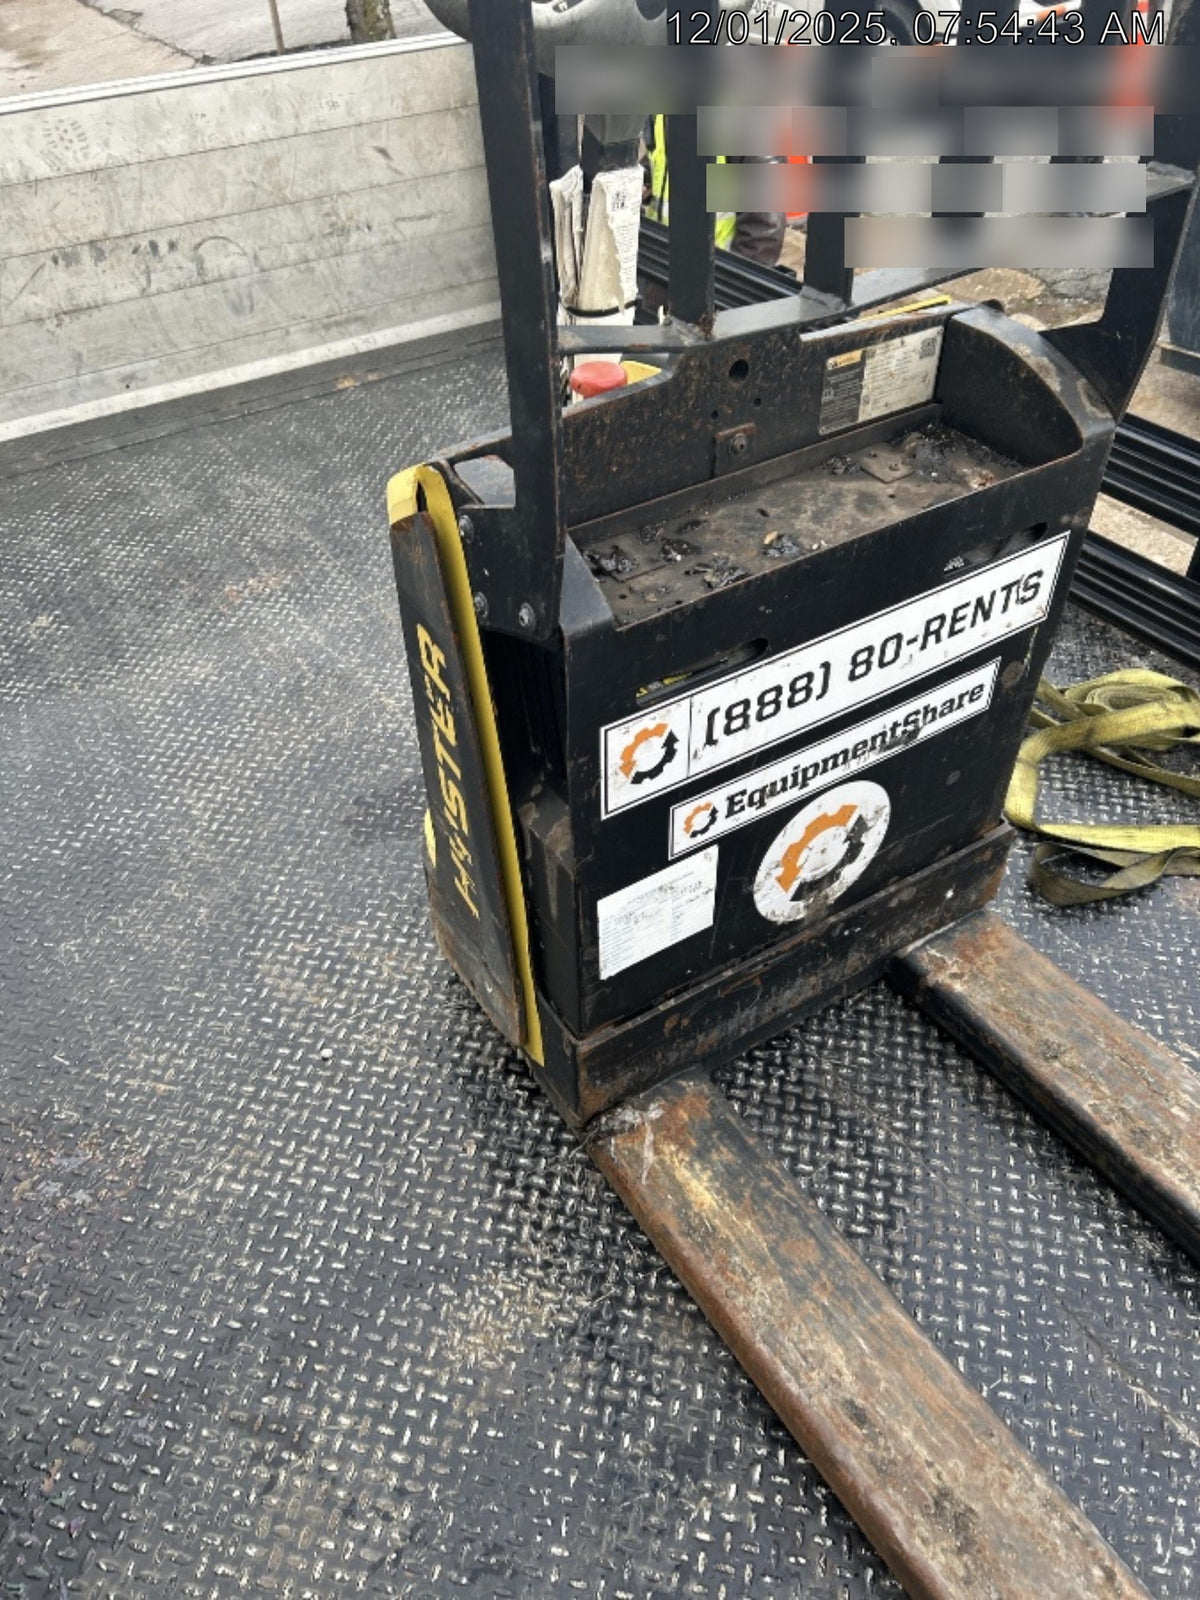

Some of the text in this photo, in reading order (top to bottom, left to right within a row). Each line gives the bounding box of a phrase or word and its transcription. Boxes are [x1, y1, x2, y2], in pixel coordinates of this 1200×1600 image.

[705, 569, 1044, 746] (888) 80-RENTS
[725, 683, 985, 818] EquipmentShare
